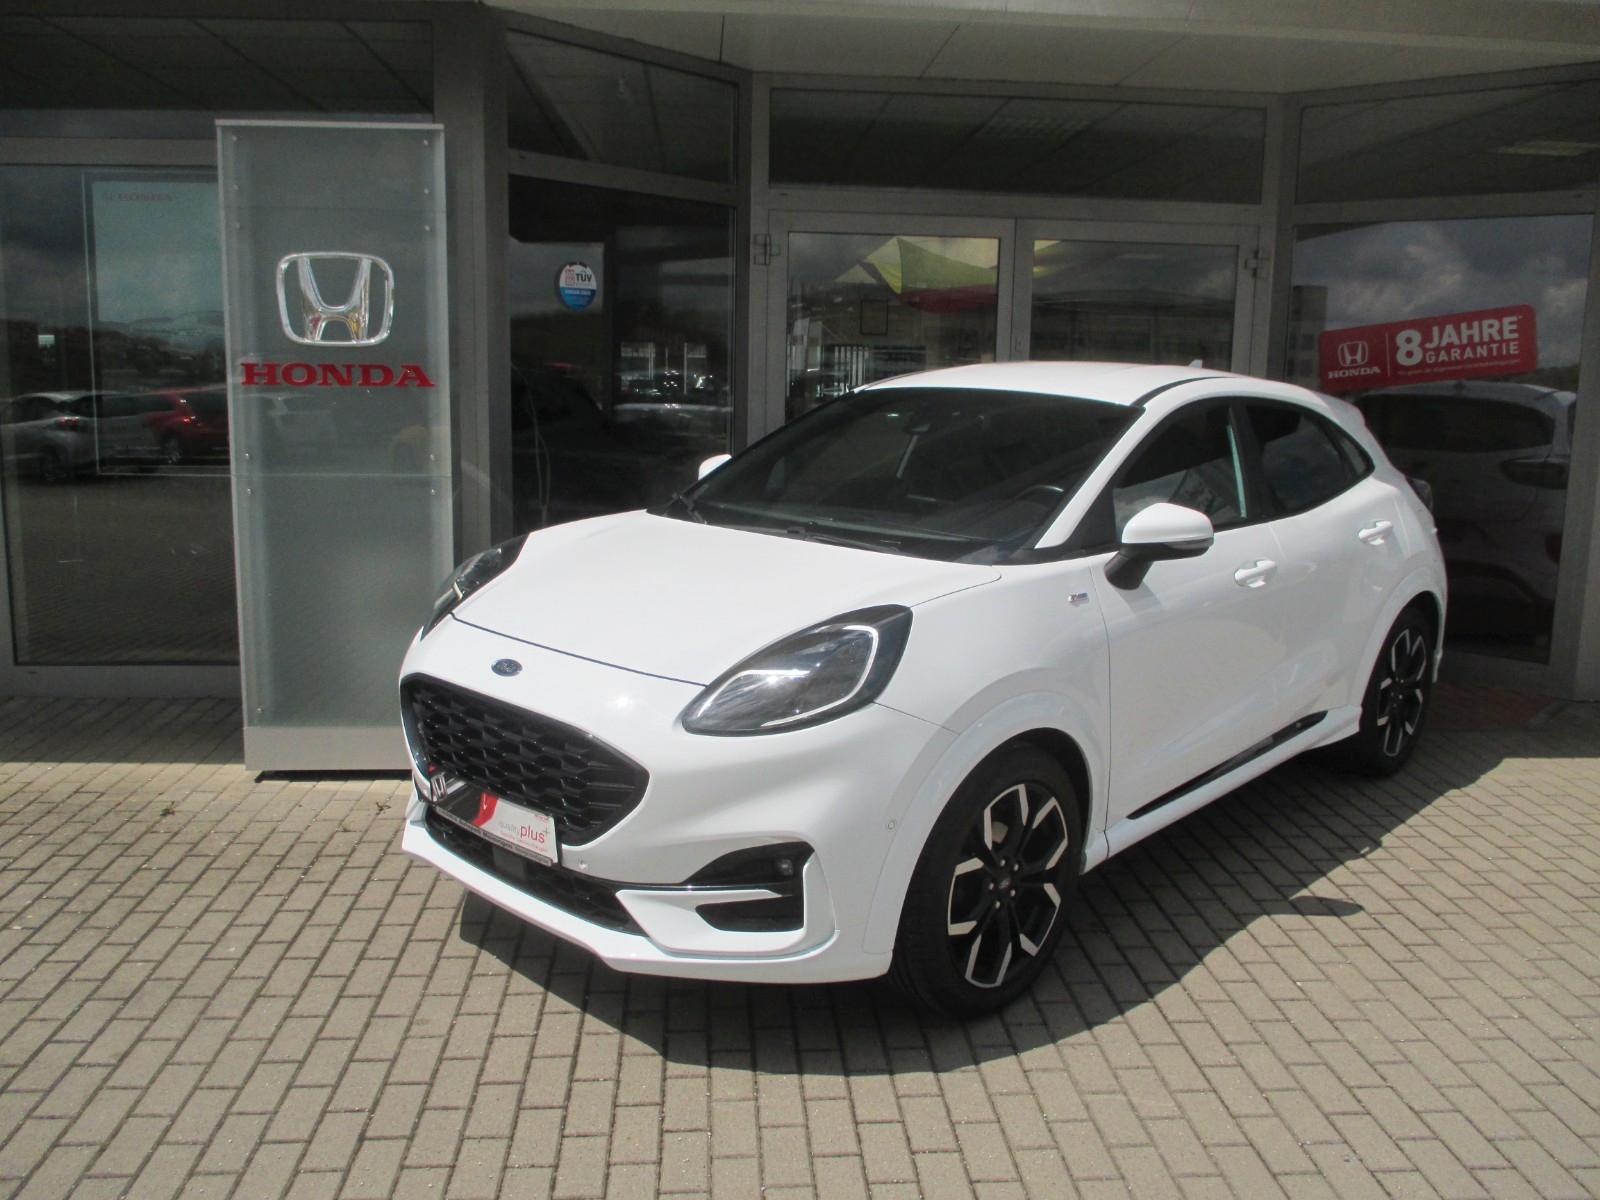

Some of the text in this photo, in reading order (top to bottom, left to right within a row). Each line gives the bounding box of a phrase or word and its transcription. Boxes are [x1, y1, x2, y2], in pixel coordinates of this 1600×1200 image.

[1395, 329, 1423, 367] 8
[1425, 316, 1520, 349] JAHRE
[1425, 341, 1519, 364] GARANTIE
[240, 361, 435, 388] HONDA
[1327, 365, 1382, 379] HONDA
